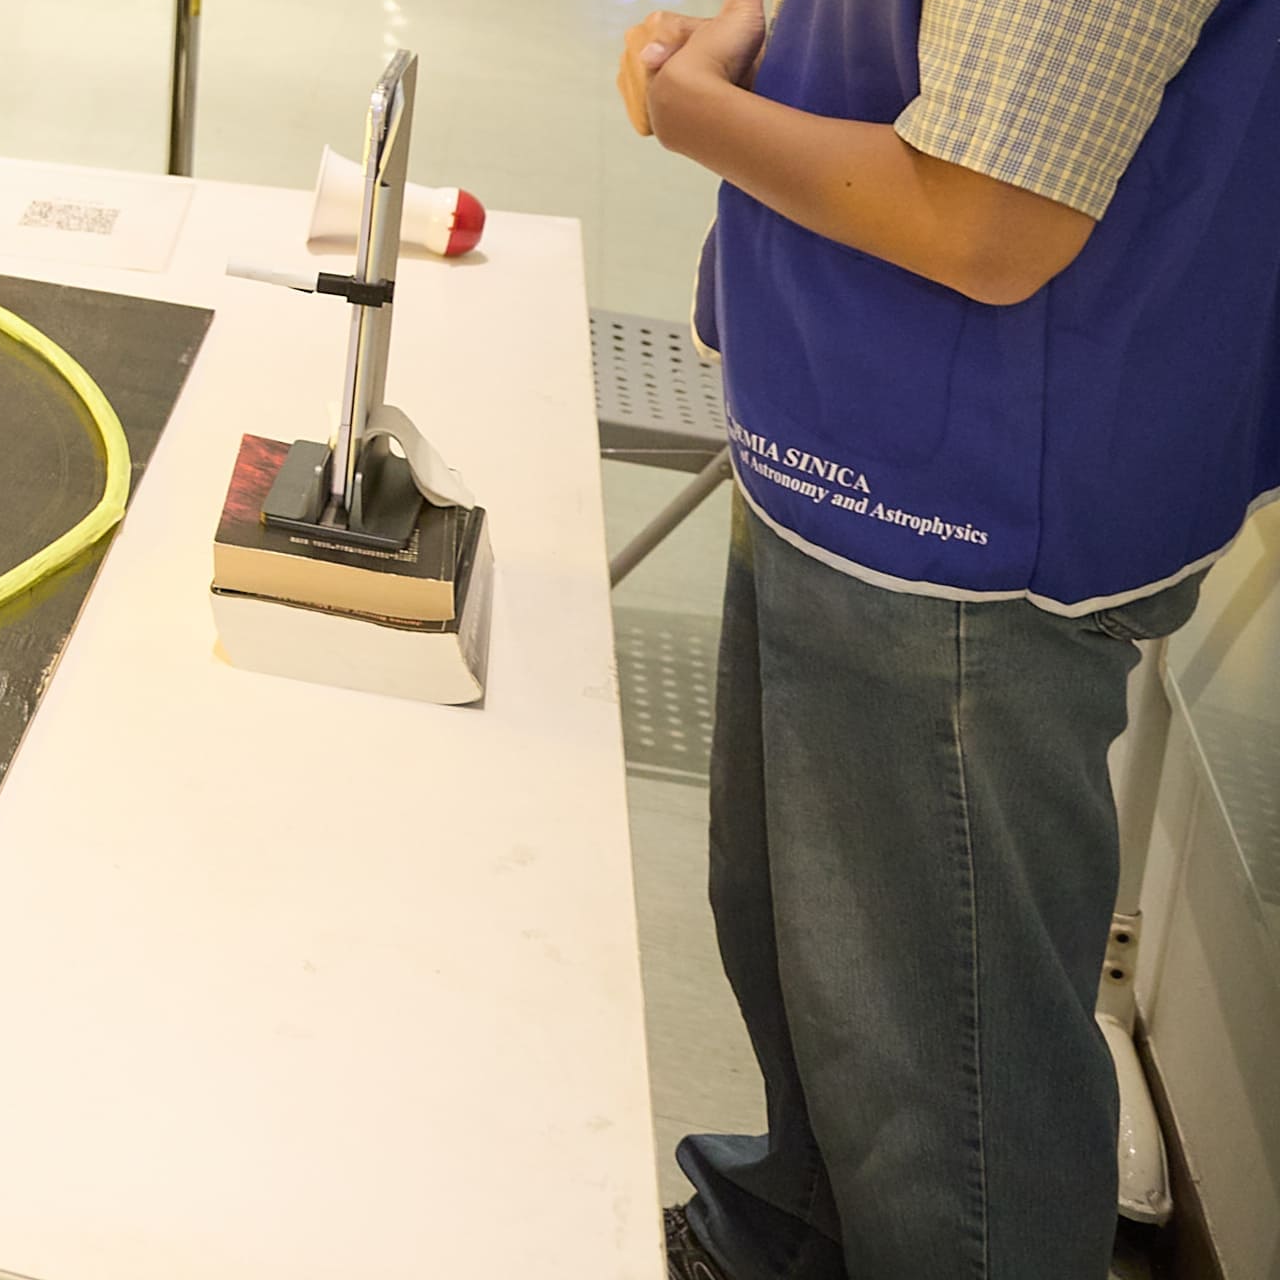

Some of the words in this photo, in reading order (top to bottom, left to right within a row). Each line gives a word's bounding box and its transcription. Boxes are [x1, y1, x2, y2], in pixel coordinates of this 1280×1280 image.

[750, 456, 830, 504] Astronomy
[831, 492, 869, 516] and
[870, 502, 989, 546] Astrophysics
[782, 447, 871, 494] SINICA
